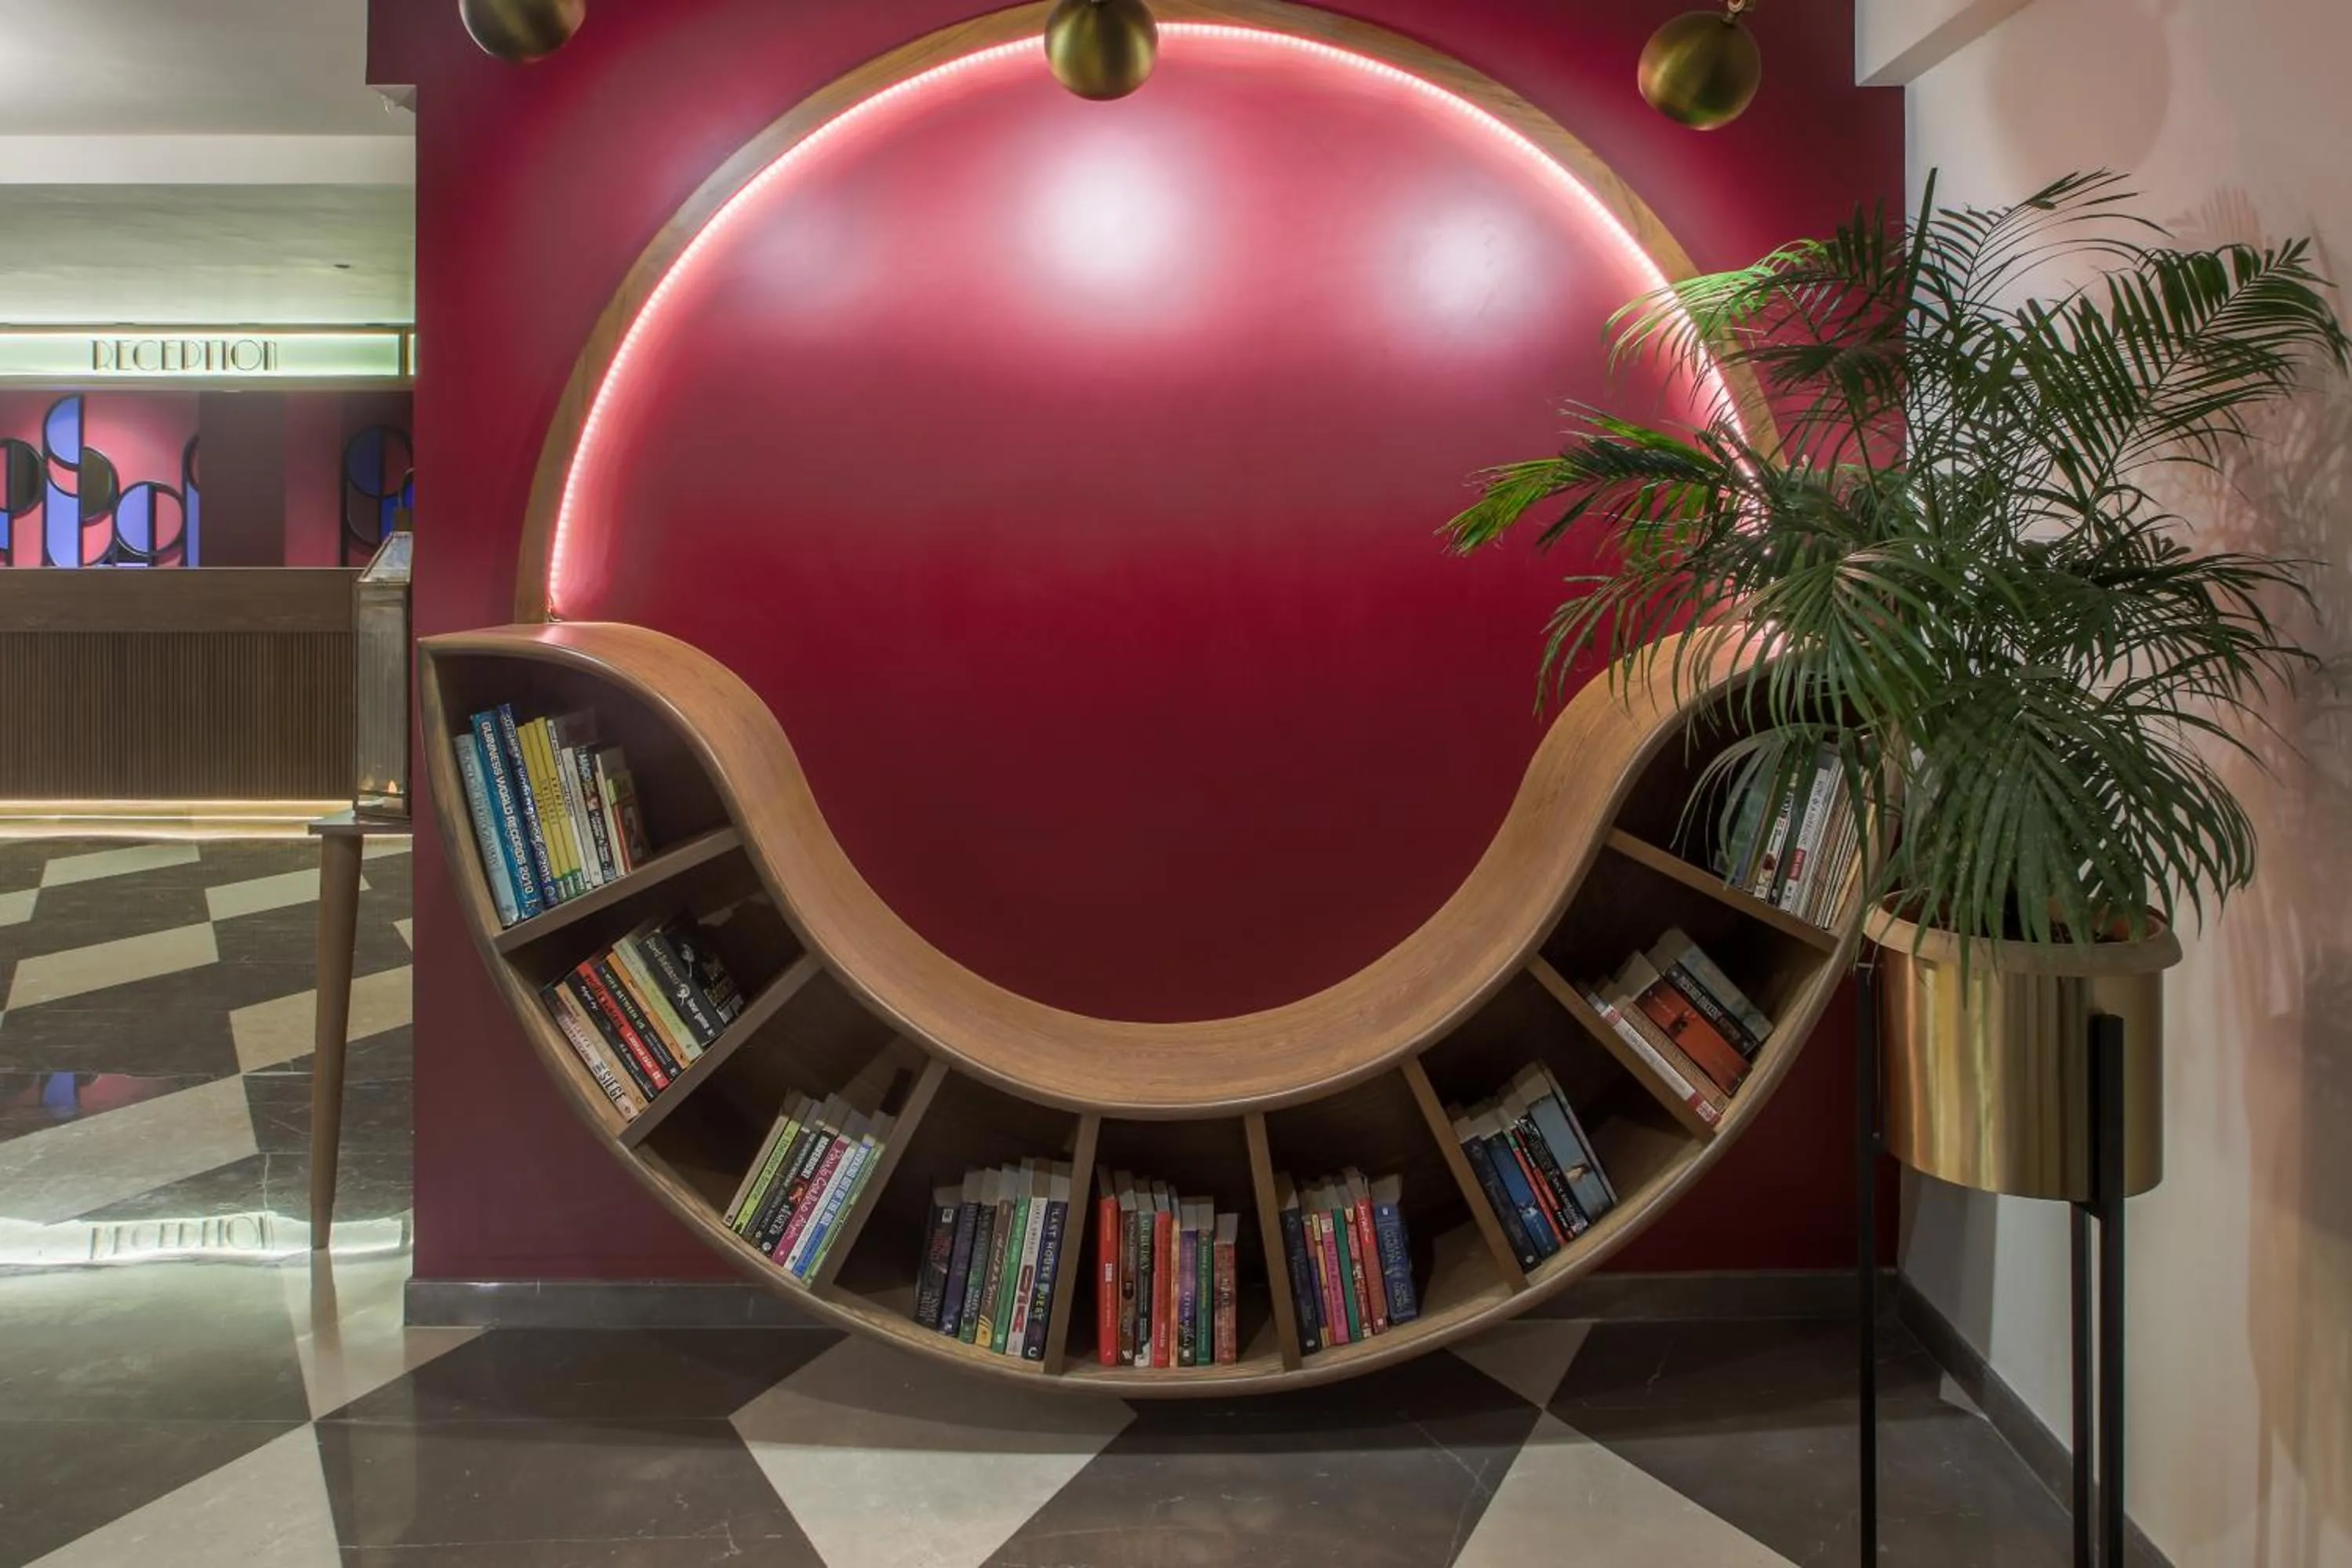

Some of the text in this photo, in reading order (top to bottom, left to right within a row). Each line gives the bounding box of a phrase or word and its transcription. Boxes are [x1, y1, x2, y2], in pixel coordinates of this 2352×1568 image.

[92, 339, 277, 371] RECEPTION
[494, 775, 515, 816] WORLD
[504, 815, 528, 866] RECORDS
[517, 864, 534, 895] 2010
[597, 1069, 627, 1104] SIEGE
